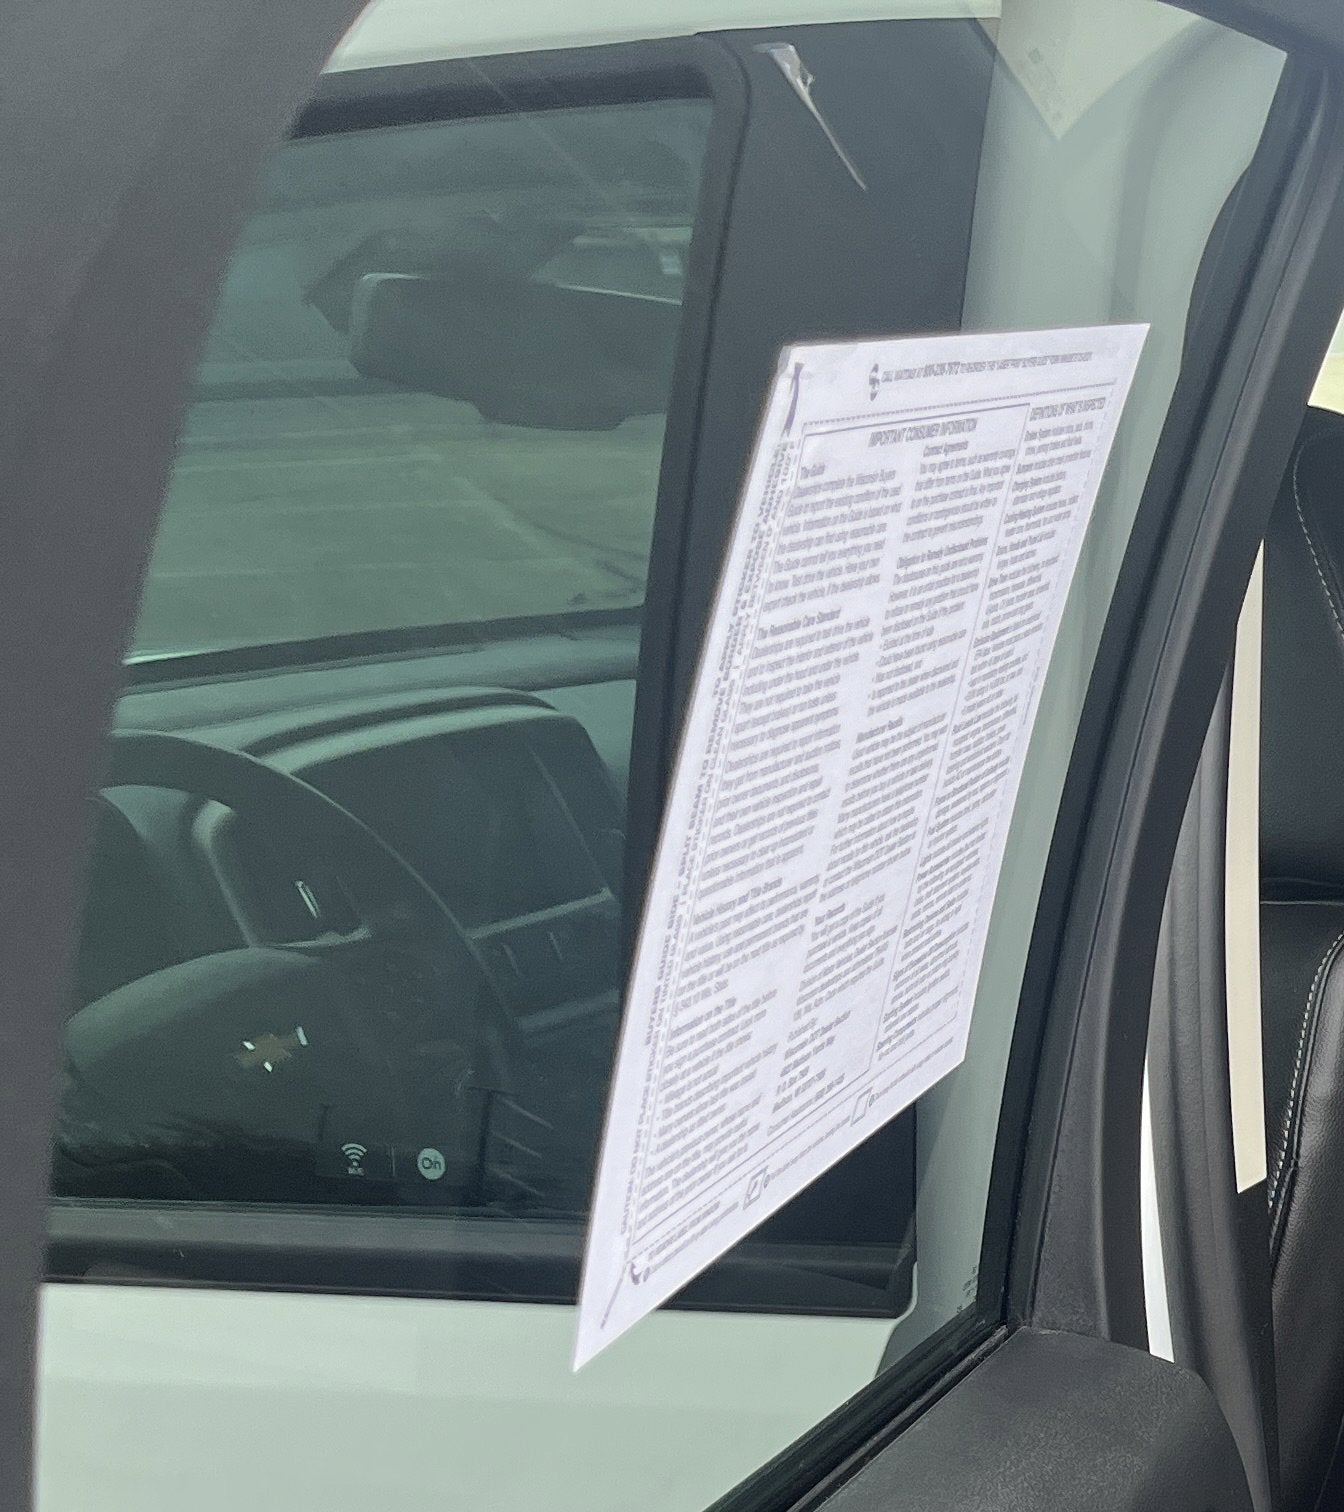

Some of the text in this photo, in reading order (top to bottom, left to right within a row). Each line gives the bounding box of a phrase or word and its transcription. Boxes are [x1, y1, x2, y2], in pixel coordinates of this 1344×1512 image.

[730, 547, 754, 618] STICKER
[655, 932, 672, 982] GUIDE
[676, 832, 693, 878] SPLIT
